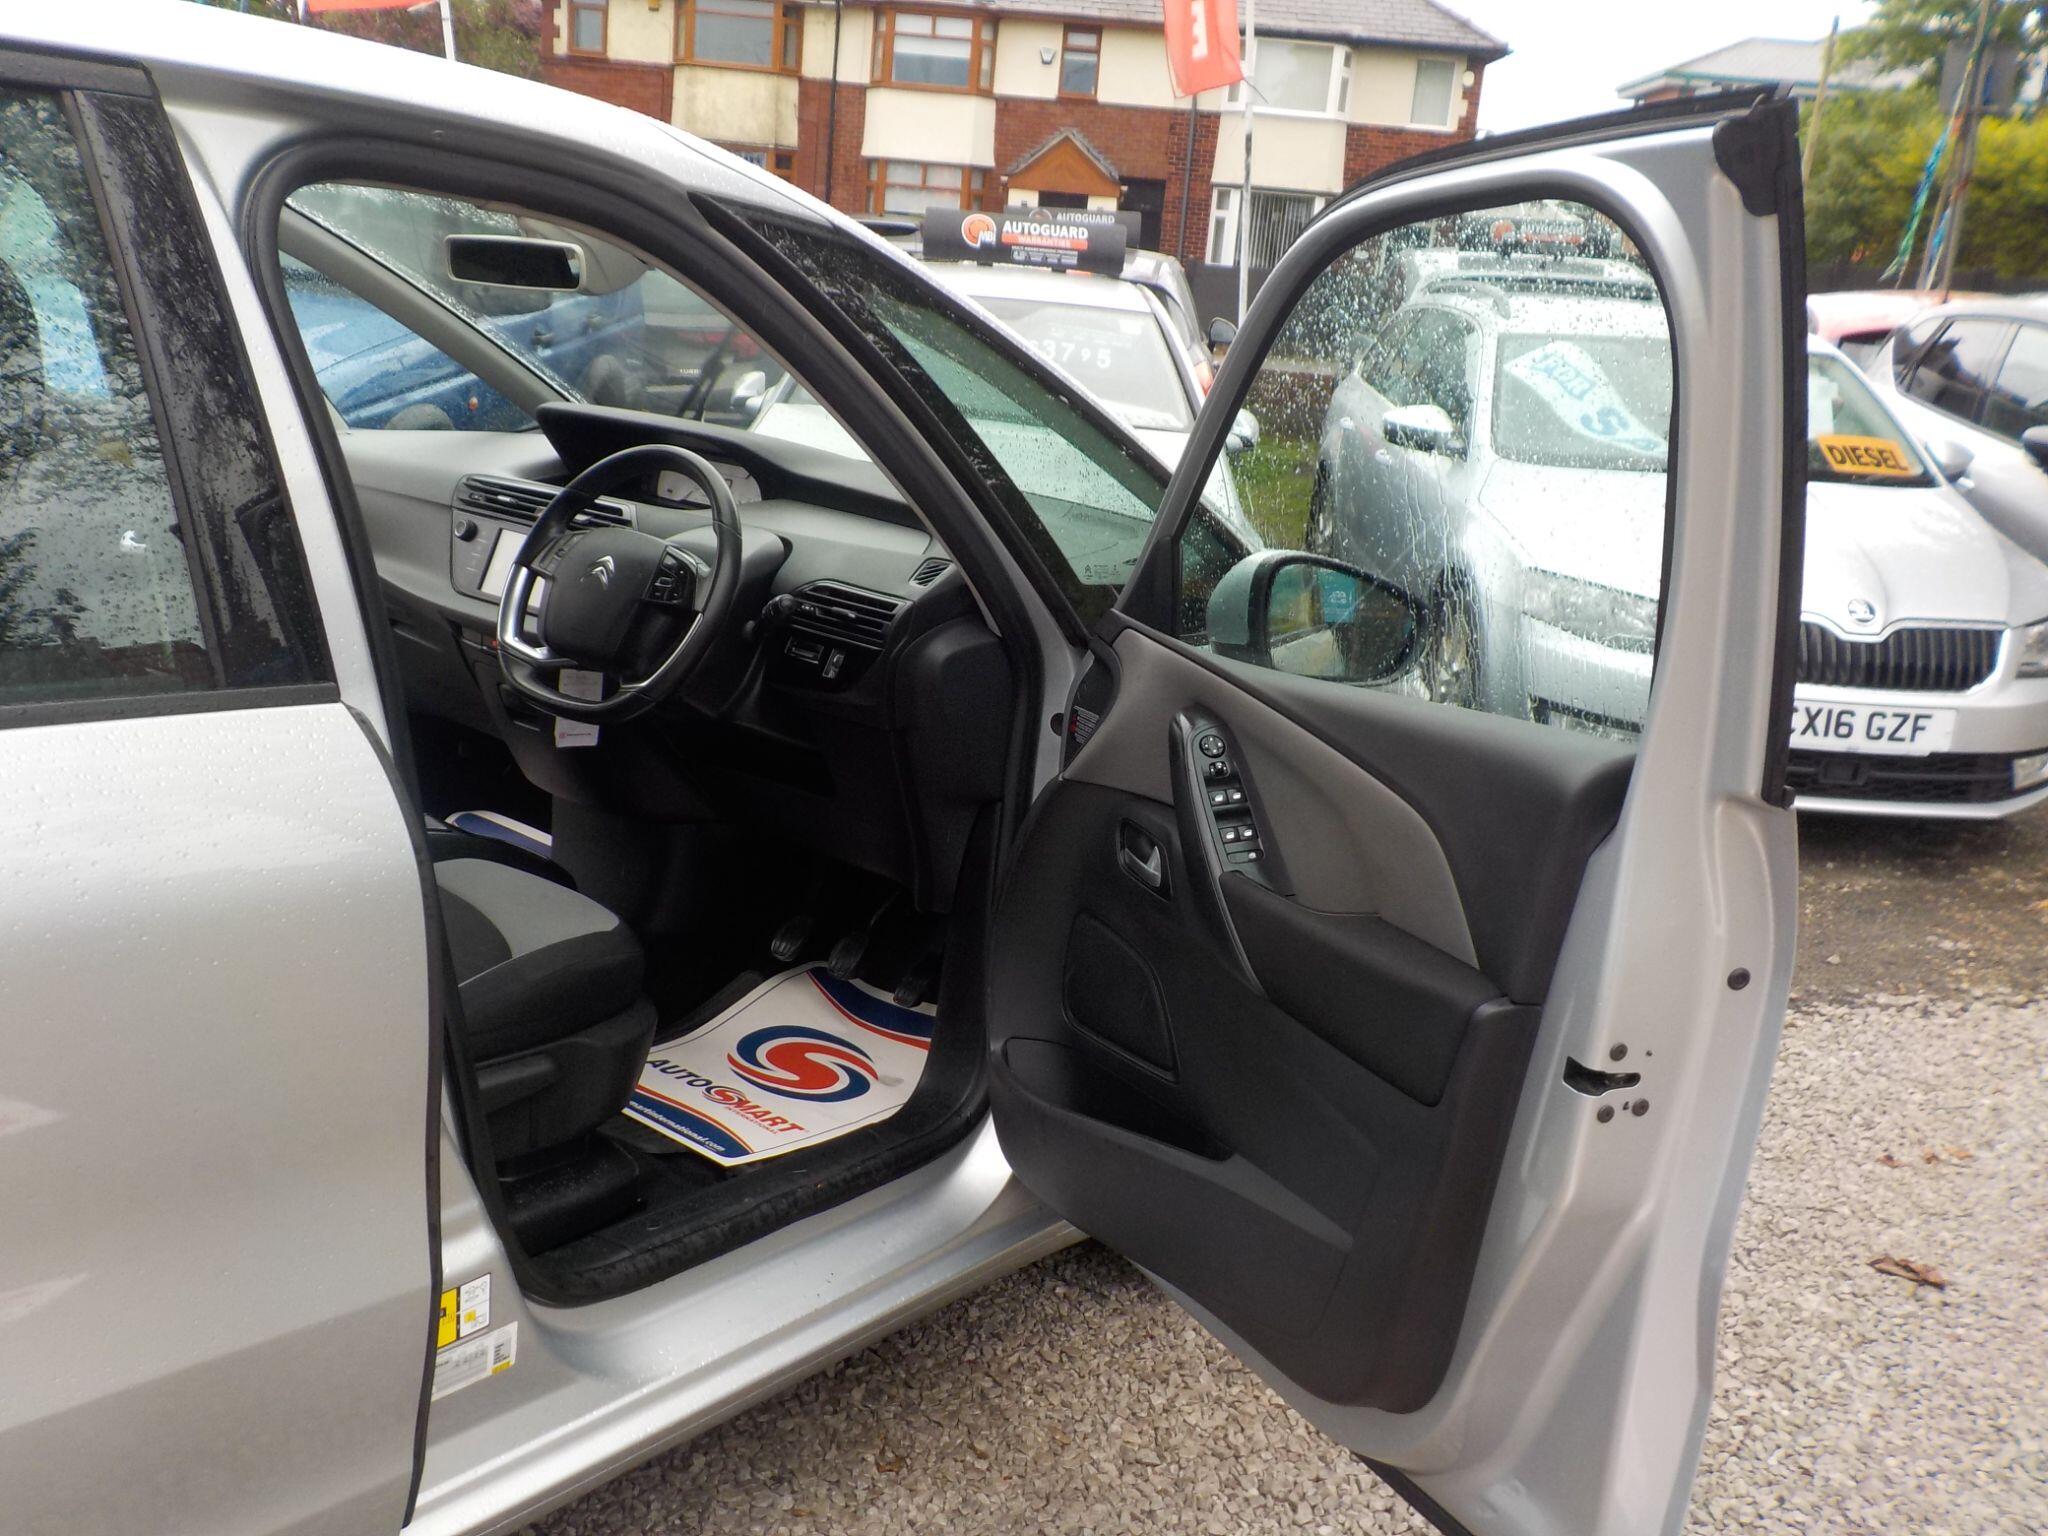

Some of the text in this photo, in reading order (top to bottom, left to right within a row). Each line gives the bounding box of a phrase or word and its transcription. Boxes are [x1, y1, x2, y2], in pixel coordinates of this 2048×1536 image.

[1002, 220, 1089, 239] AUTOGUARD
[1057, 212, 1115, 224] AUTOGUARD
[1825, 444, 1909, 471] DIESEL
[1866, 711, 1933, 743] GZF
